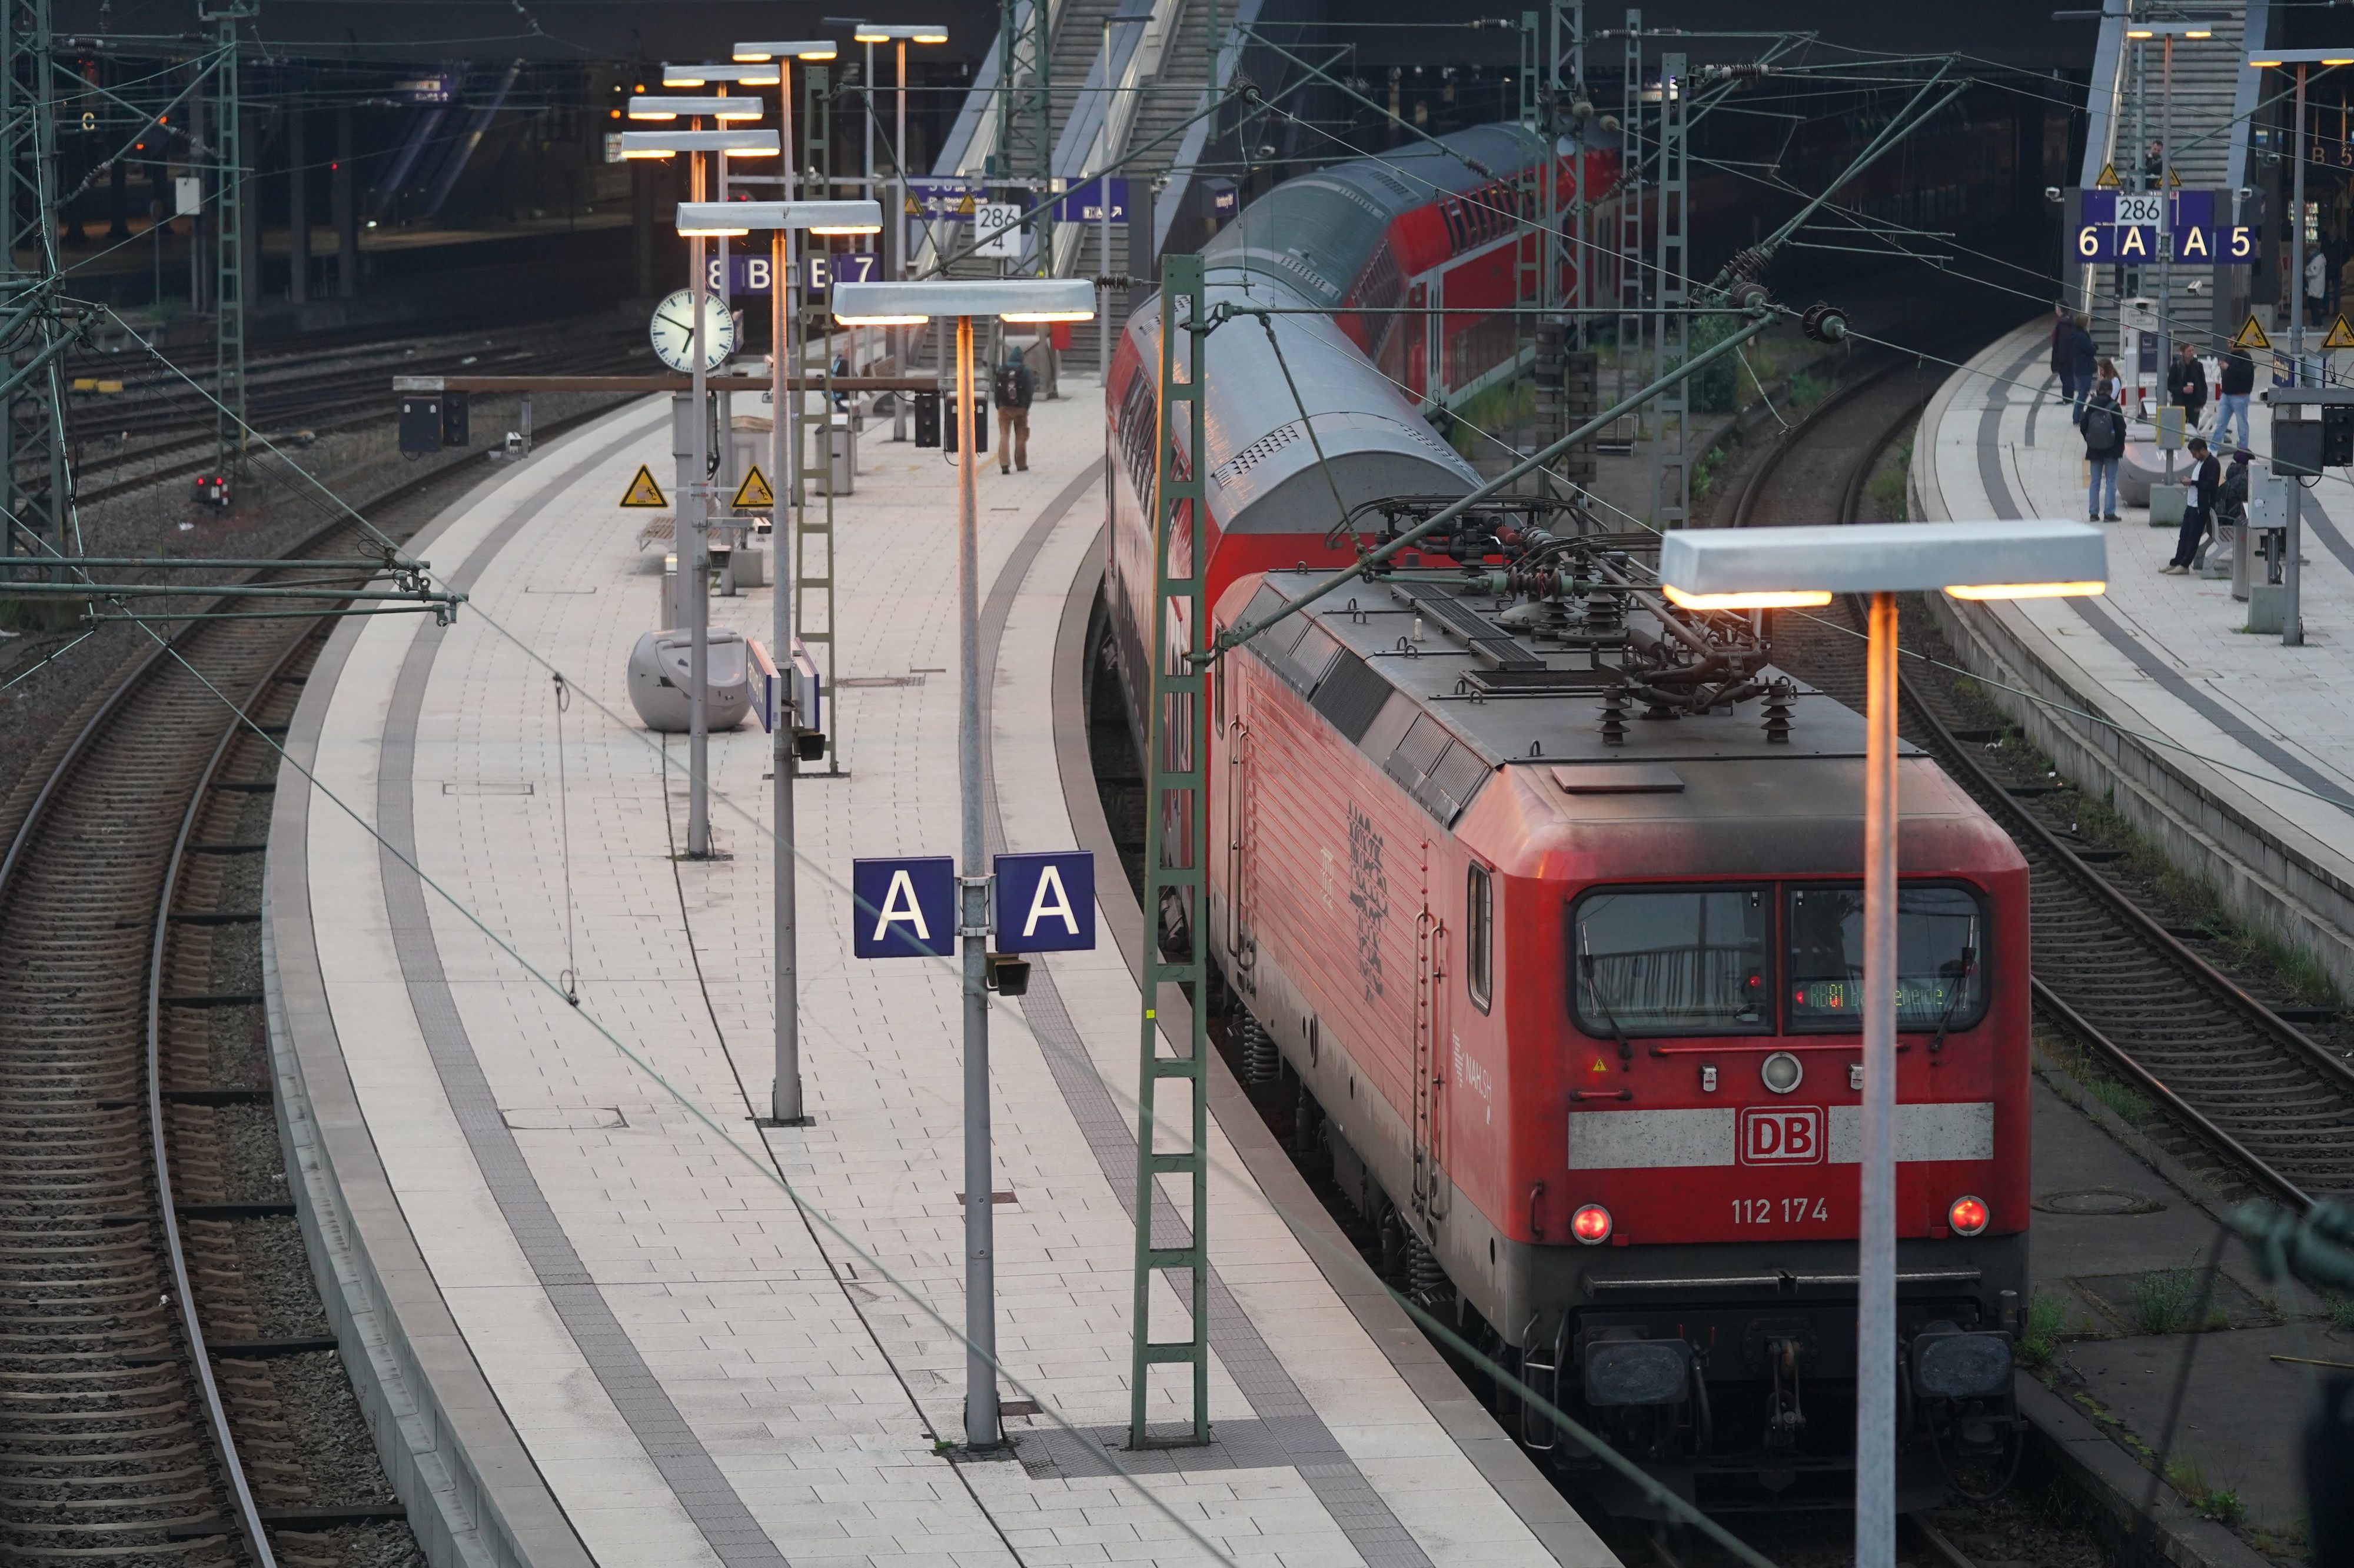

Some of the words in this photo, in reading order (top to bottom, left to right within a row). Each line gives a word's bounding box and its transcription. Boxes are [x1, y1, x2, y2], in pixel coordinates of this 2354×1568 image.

[2313, 147, 2325, 165] B
[2341, 146, 2353, 166] 5
[980, 208, 1015, 228] 286
[2120, 200, 2160, 220] 286
[992, 233, 1005, 251] 4
[2079, 226, 2099, 256] 6
[2122, 226, 2146, 255] A
[2183, 226, 2207, 256] A
[2231, 227, 2250, 257] 5
[749, 259, 770, 289] B
[855, 257, 874, 282] 7
[873, 870, 930, 941] A
[1023, 865, 1079, 937] A
[1811, 984, 1843, 1007] RB81
[1466, 1053, 1492, 1104] NAH.SH
[1753, 1117, 1812, 1155] DB
[1732, 1199, 1771, 1224] 112
[1781, 1197, 1828, 1223] 174
